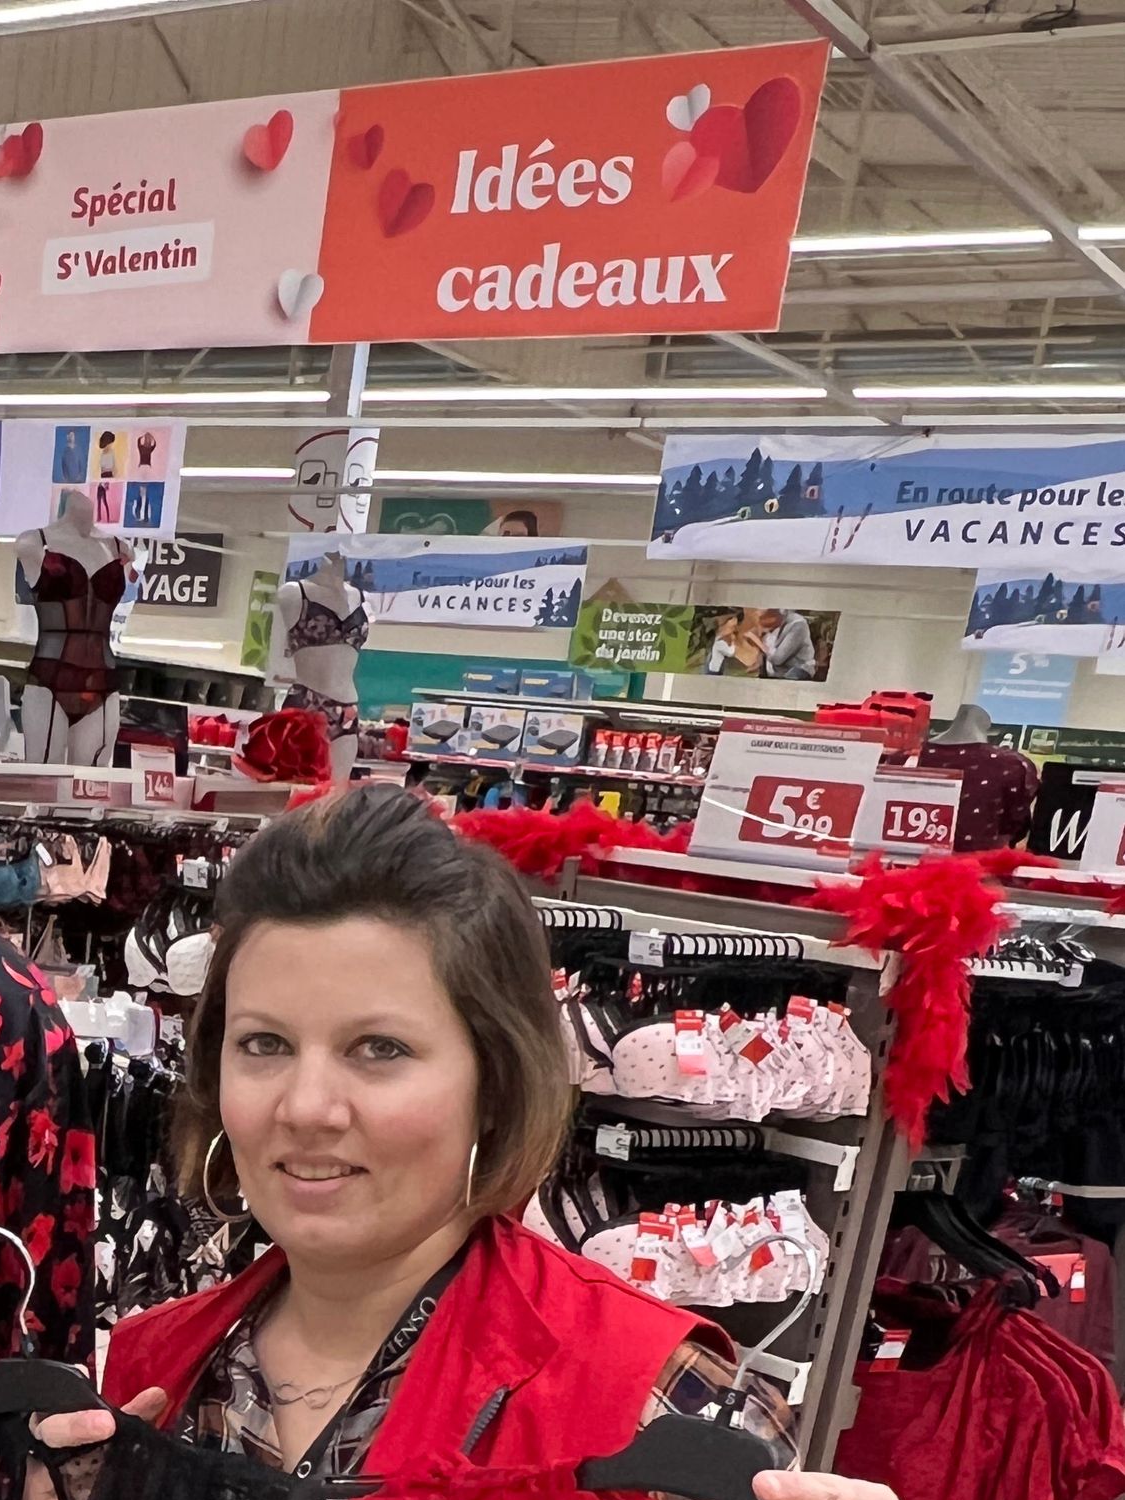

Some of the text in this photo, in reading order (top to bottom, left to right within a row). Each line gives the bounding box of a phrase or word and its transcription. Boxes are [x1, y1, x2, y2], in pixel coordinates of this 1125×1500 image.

[450, 138, 634, 214] Idées
[71, 178, 177, 227] Spécial
[85, 238, 197, 277] Valentin
[437, 242, 733, 312] cadeaux
[896, 480, 929, 504] En
[936, 483, 1011, 505] route
[1018, 487, 1090, 512] pour
[905, 518, 1125, 546] VACANCES
[141, 574, 209, 603] YAGE
[476, 576, 510, 594] pour
[513, 574, 536, 589] les
[417, 594, 533, 613] VACANCES
[601, 608, 663, 625] Devenez
[598, 628, 658, 642] une star
[615, 643, 660, 663] jardin
